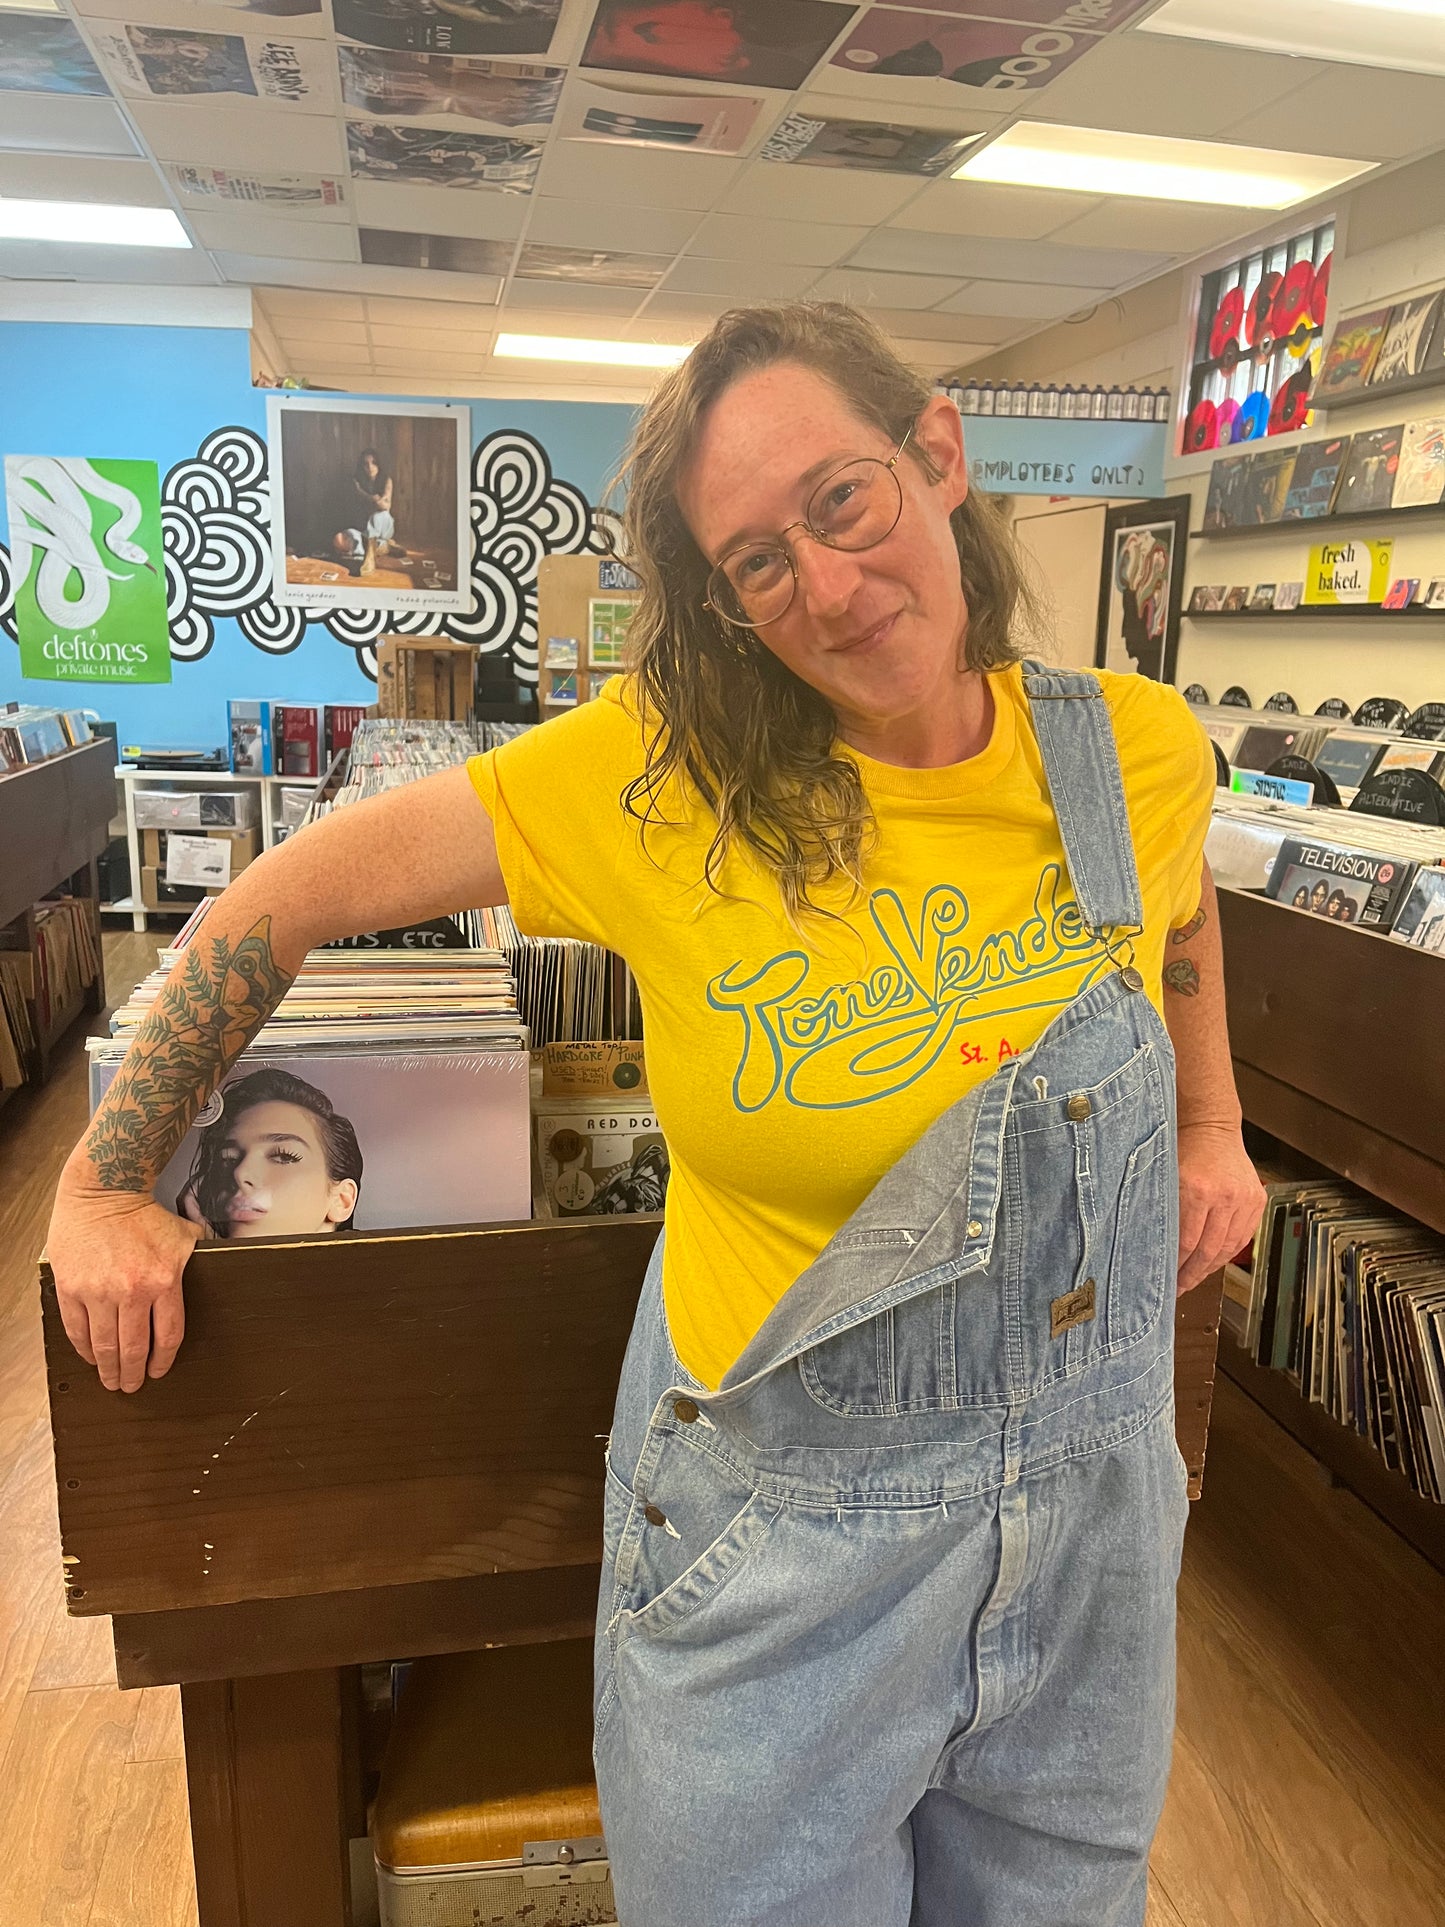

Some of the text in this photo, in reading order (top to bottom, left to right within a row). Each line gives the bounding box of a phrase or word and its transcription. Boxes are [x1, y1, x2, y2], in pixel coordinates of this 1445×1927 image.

[974, 459, 1077, 484] EMPLOYEES
[1321, 543, 1355, 565] fresh
[1318, 570, 1361, 590] baked.
[42, 632, 148, 662] deftones
[56, 660, 138, 677] private music
[1281, 758, 1309, 771] INDIE
[1379, 774, 1417, 788] INDIE
[1358, 792, 1425, 815] ALTERNATIVE
[1300, 846, 1379, 880] TELEVISION
[402, 931, 447, 948] ETC
[547, 1047, 603, 1064] HARDCORE
[960, 1041, 989, 1065] St.
[587, 1117, 659, 1130] RED DO
